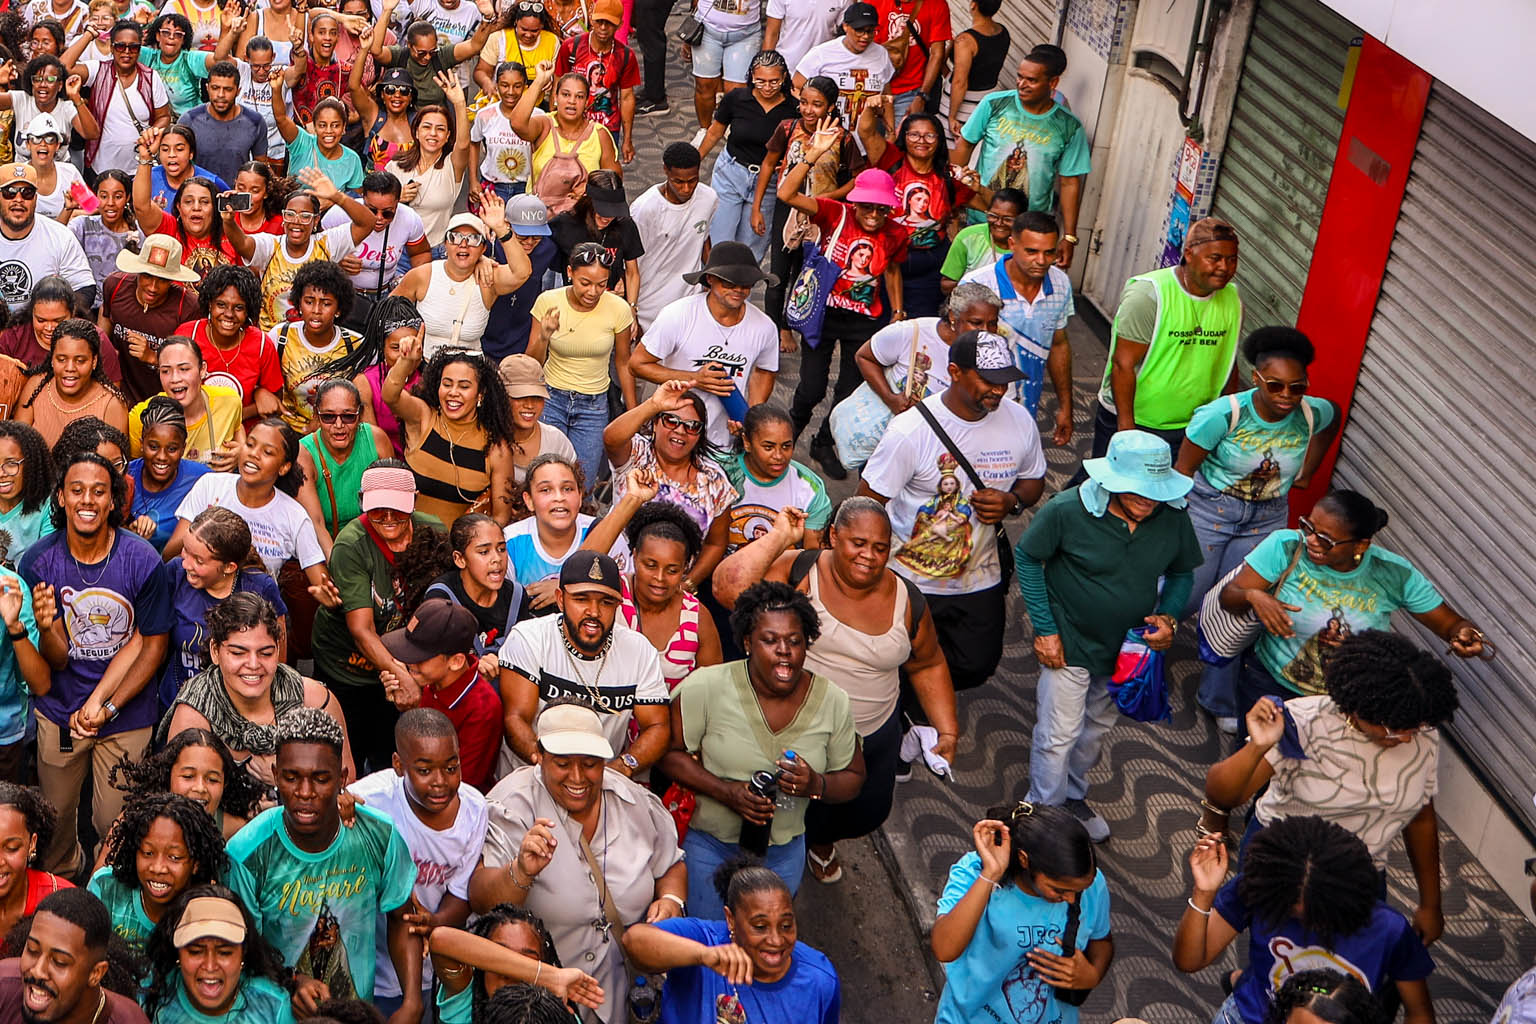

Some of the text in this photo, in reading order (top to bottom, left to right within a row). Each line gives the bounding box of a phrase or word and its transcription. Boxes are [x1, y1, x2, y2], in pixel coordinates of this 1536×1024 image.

[489, 136, 529, 146] EUCARIST
[521, 209, 544, 221] NYC
[703, 345, 747, 366] Boss
[1298, 572, 1377, 614] Nazaré
[279, 867, 369, 917] Nazaré
